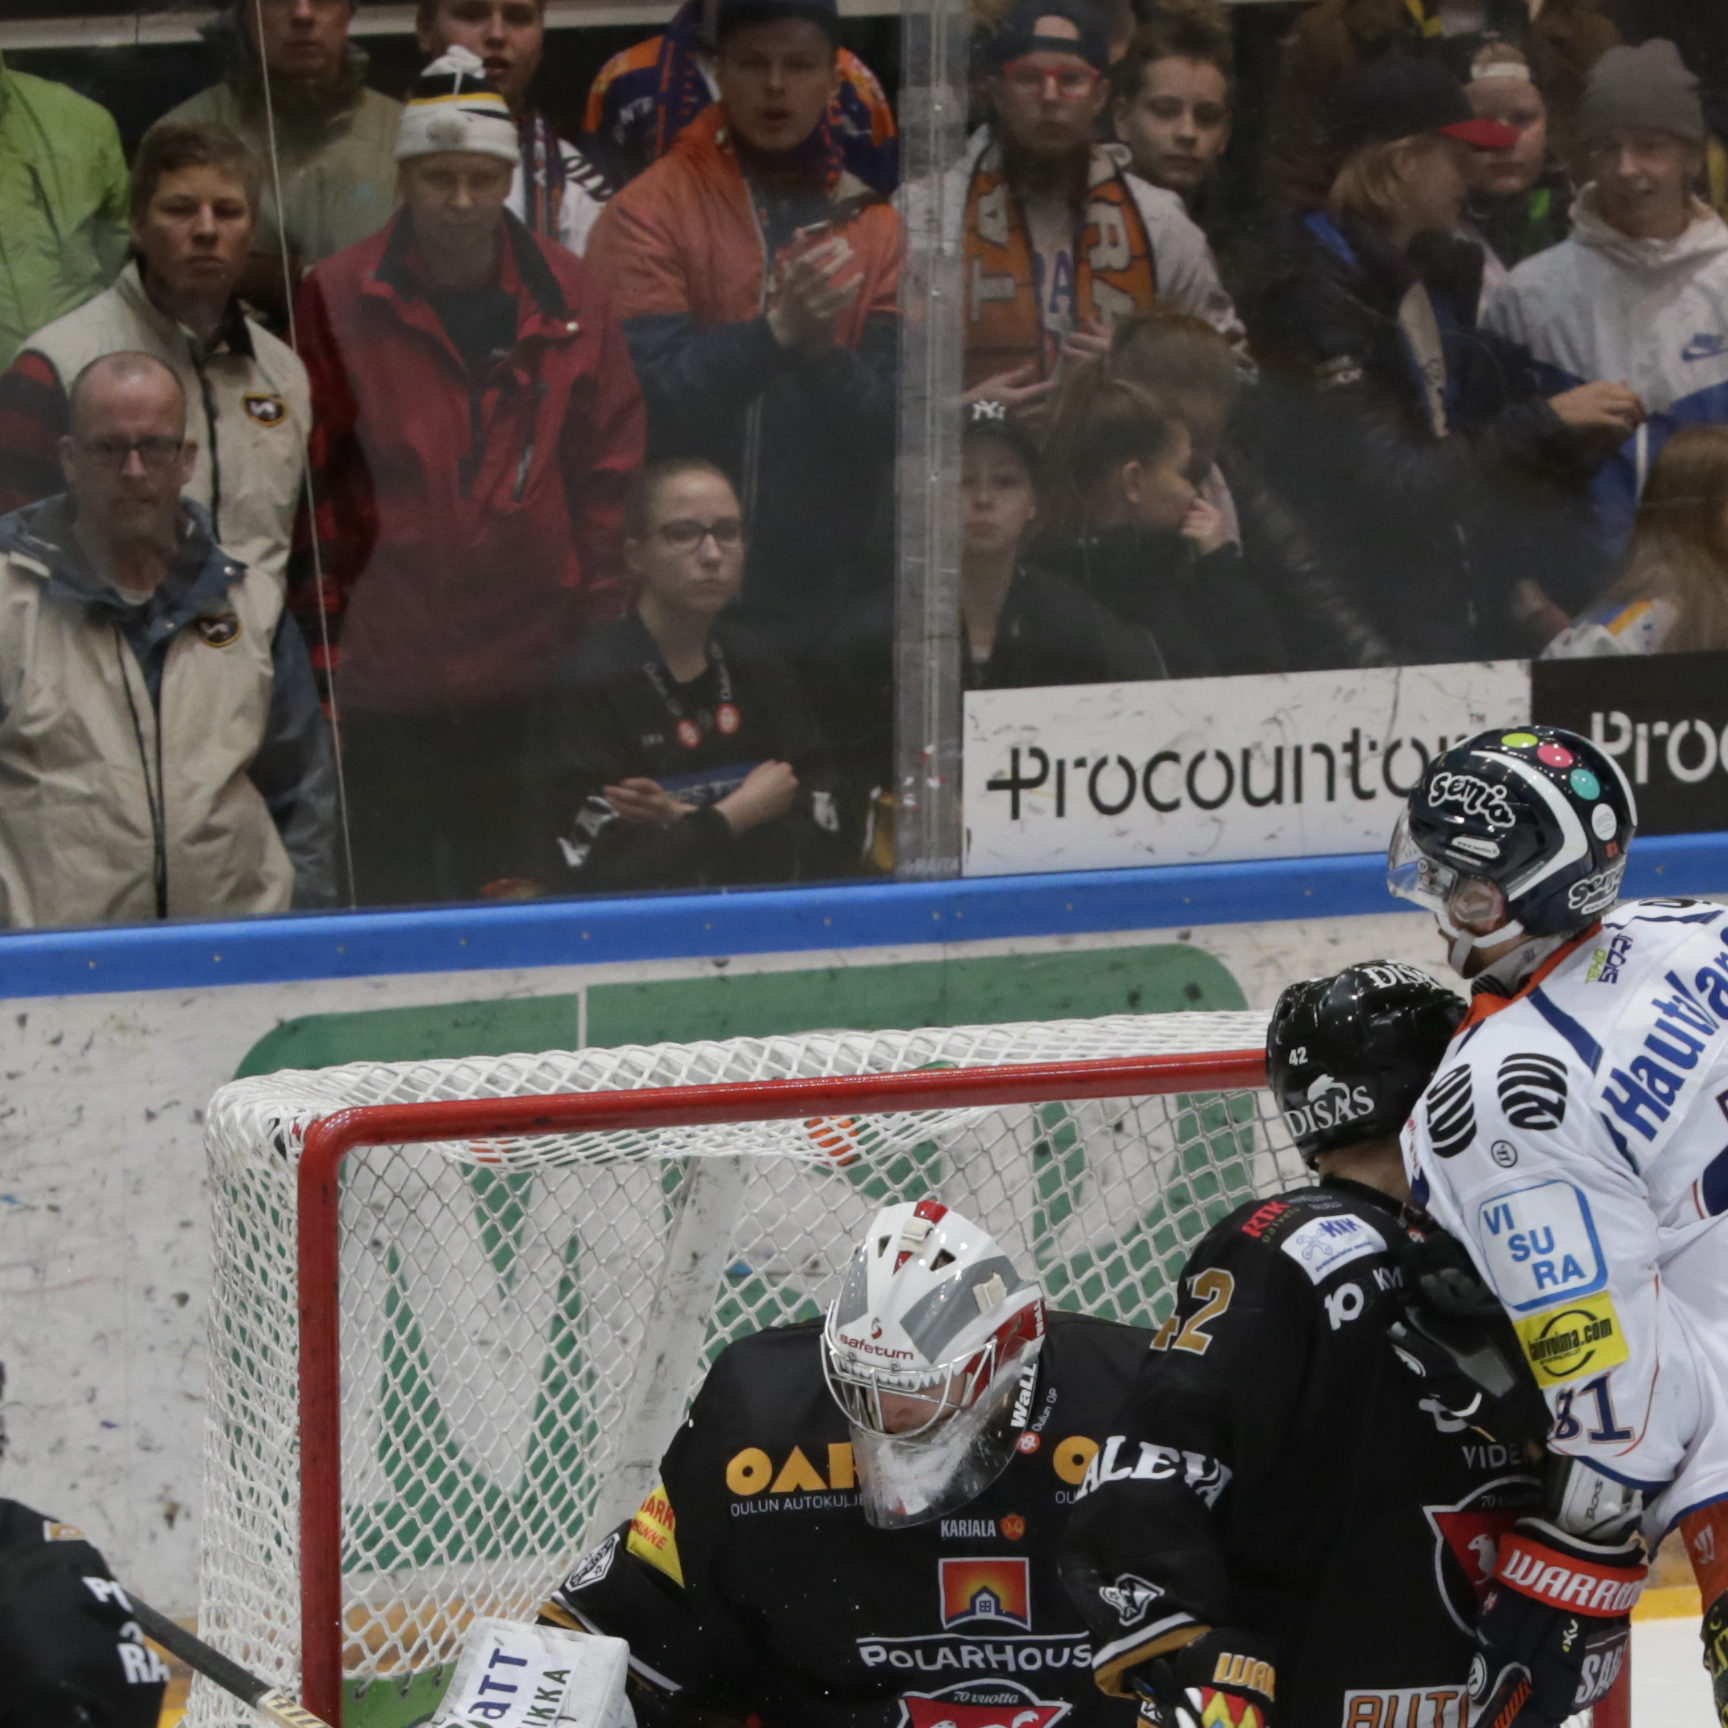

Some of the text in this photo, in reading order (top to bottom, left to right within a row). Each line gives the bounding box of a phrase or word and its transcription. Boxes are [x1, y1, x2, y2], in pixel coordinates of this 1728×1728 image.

[1283, 1084, 1376, 1138] DISAS
[730, 1499, 780, 1517] OULUN
[940, 1519, 997, 1538] KARJALA
